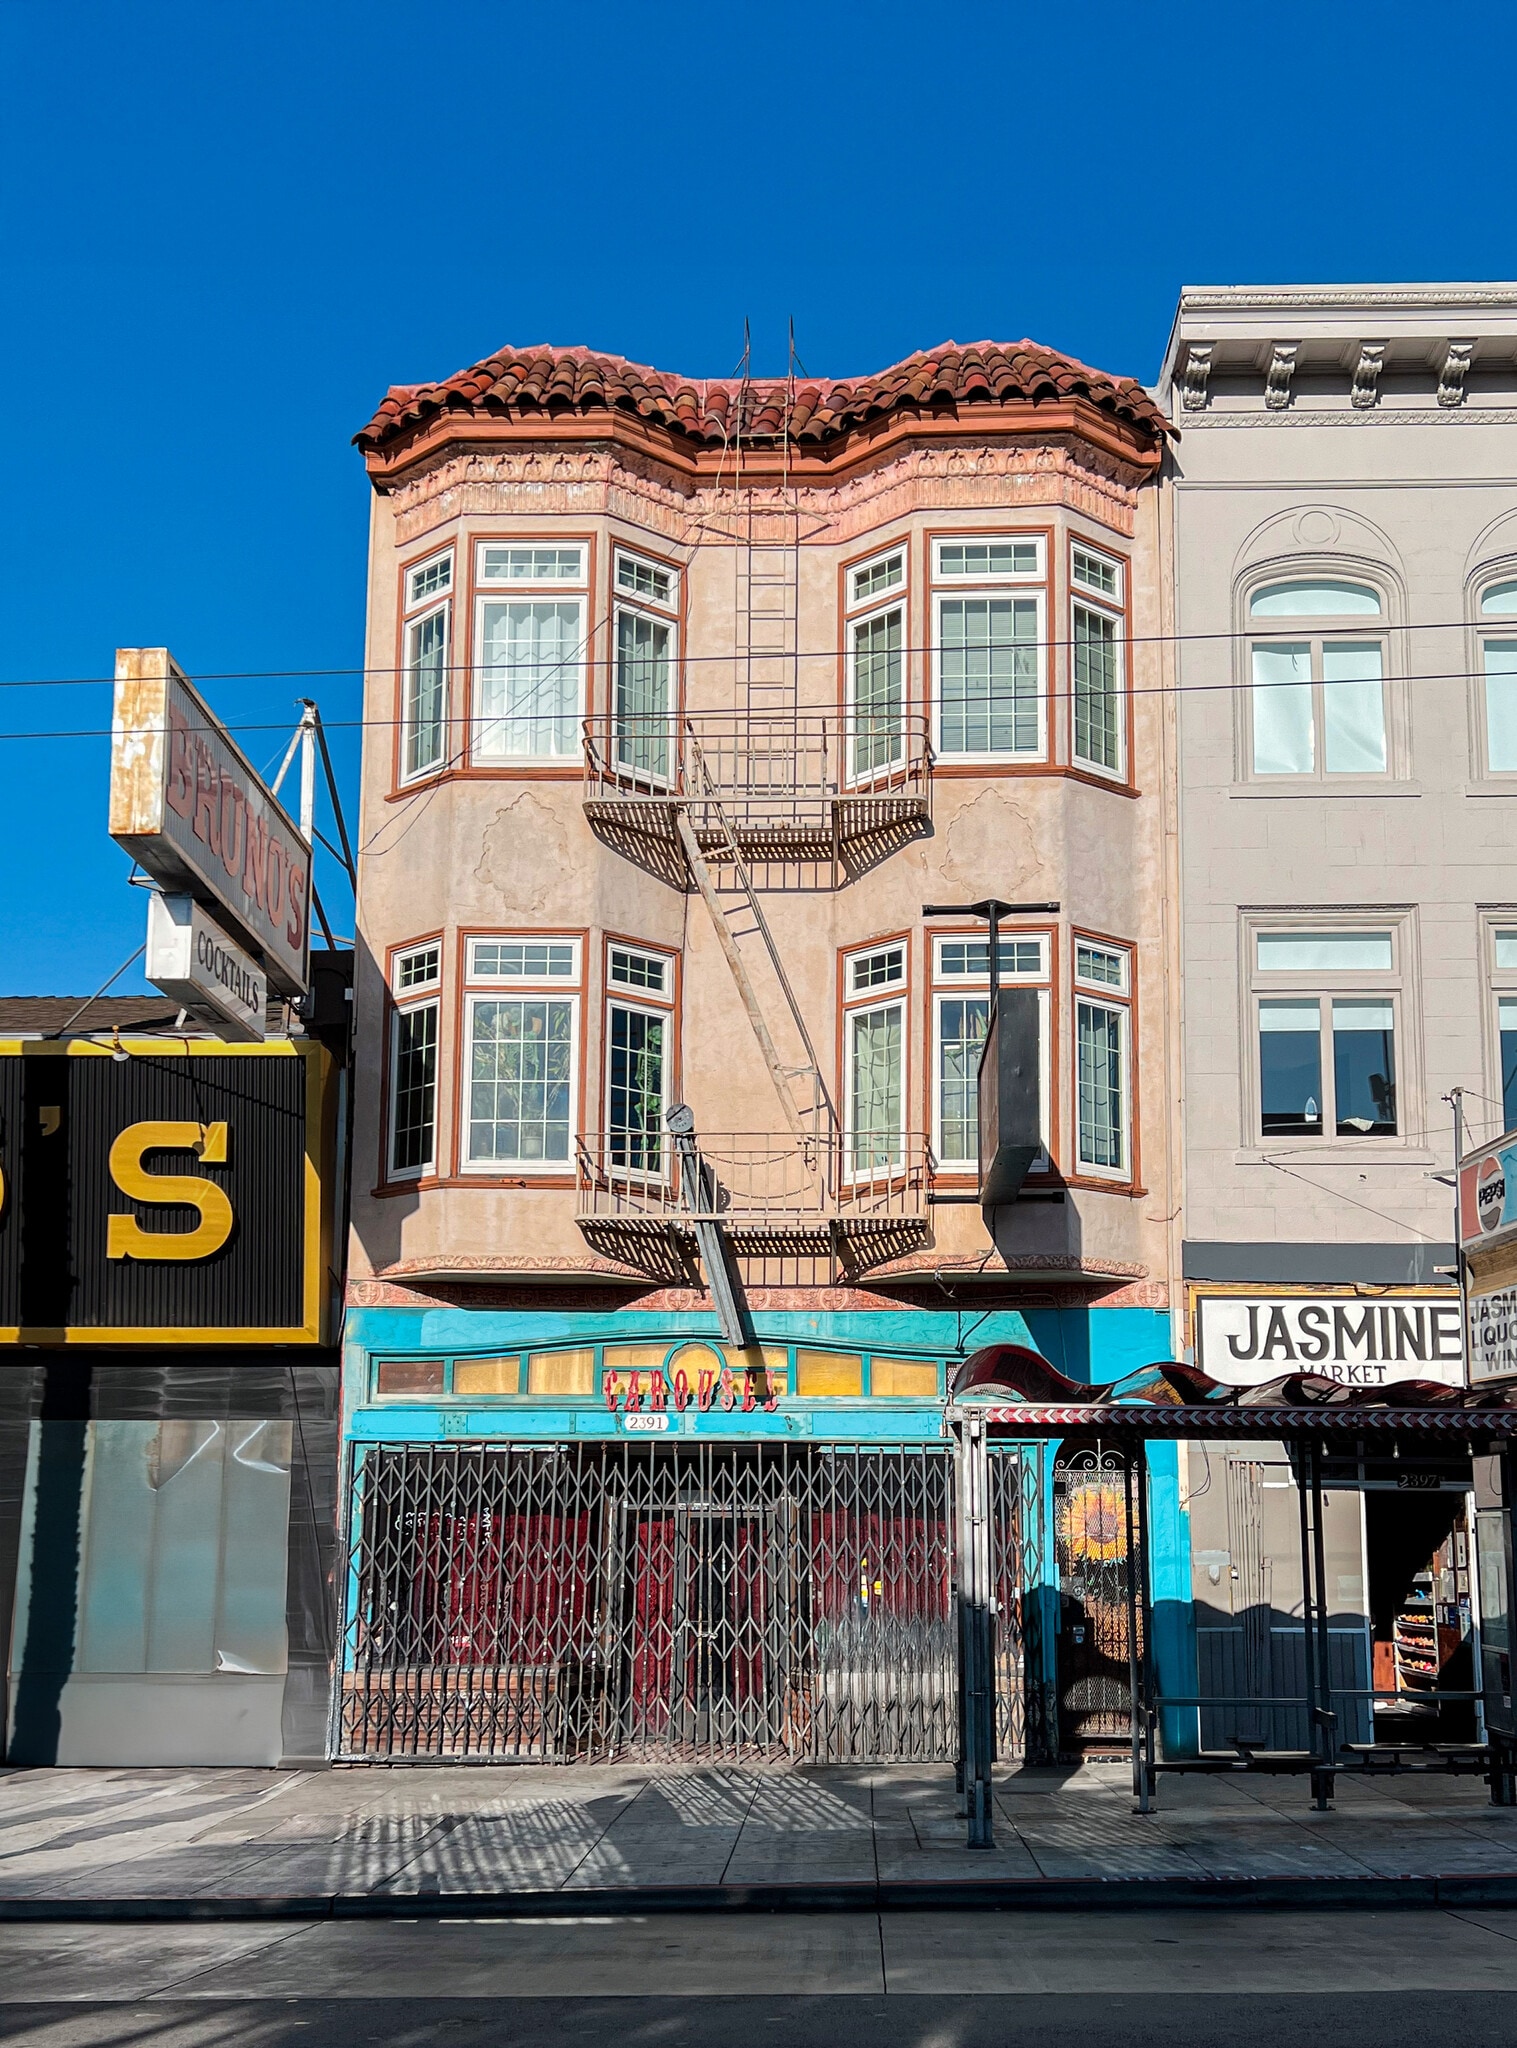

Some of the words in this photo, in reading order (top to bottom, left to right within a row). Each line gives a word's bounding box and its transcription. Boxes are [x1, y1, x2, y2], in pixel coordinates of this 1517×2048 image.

[166, 699, 304, 950] BRUNO'S
[198, 929, 259, 1014] COCKTAILS
[1479, 1178, 1505, 1207] PEPSI
[1226, 1305, 1462, 1361] JASMINE
[603, 1368, 778, 1412] CAROUSEL
[629, 1416, 663, 1430] 2391
[1399, 1474, 1438, 1489] 2397
